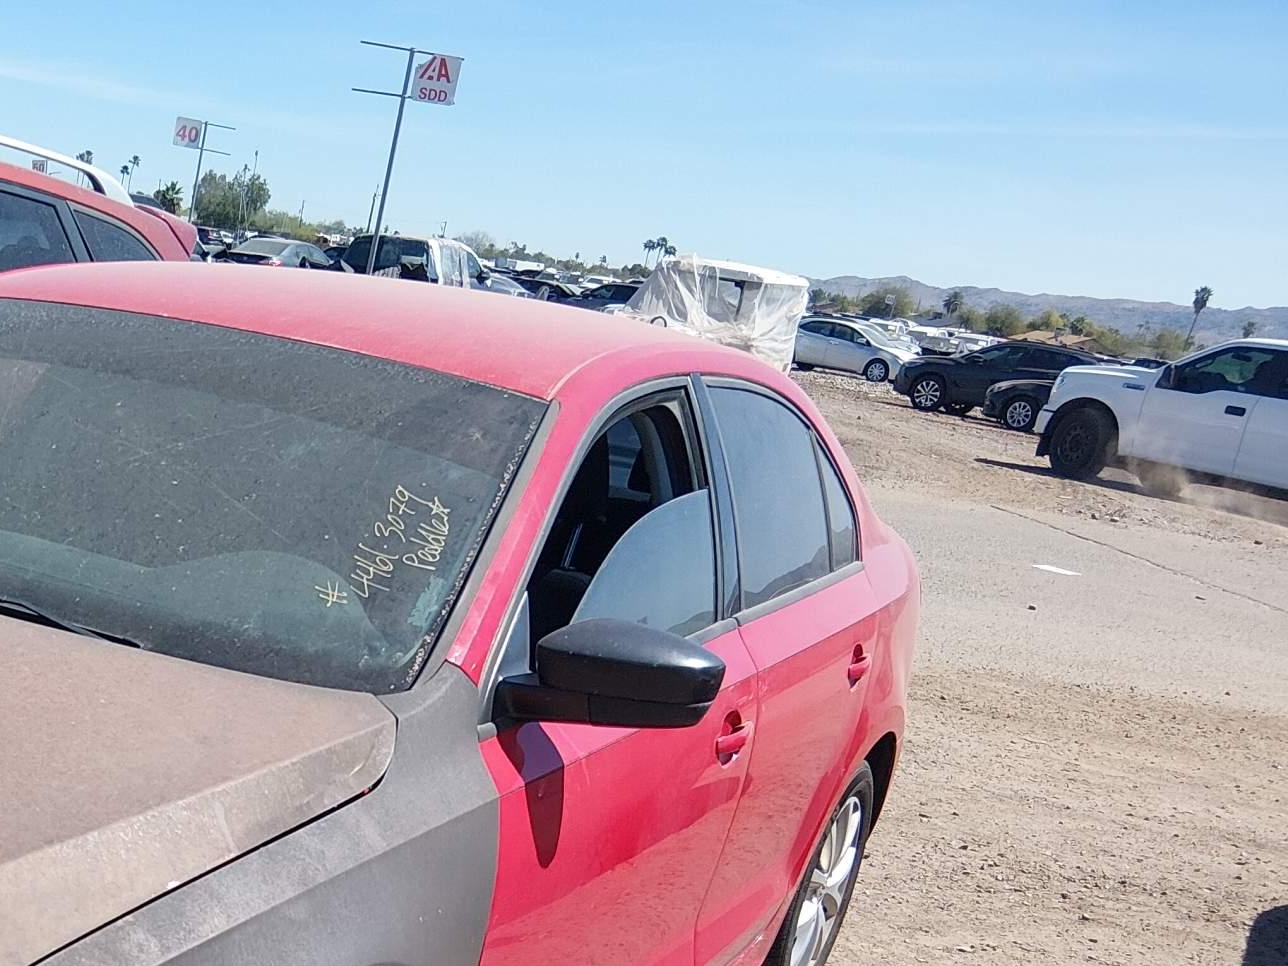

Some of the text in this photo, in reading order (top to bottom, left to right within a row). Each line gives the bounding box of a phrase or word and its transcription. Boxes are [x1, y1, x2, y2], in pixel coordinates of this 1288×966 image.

[418, 87, 448, 103] SDD
[175, 125, 199, 143] 40
[314, 579, 348, 607] #
